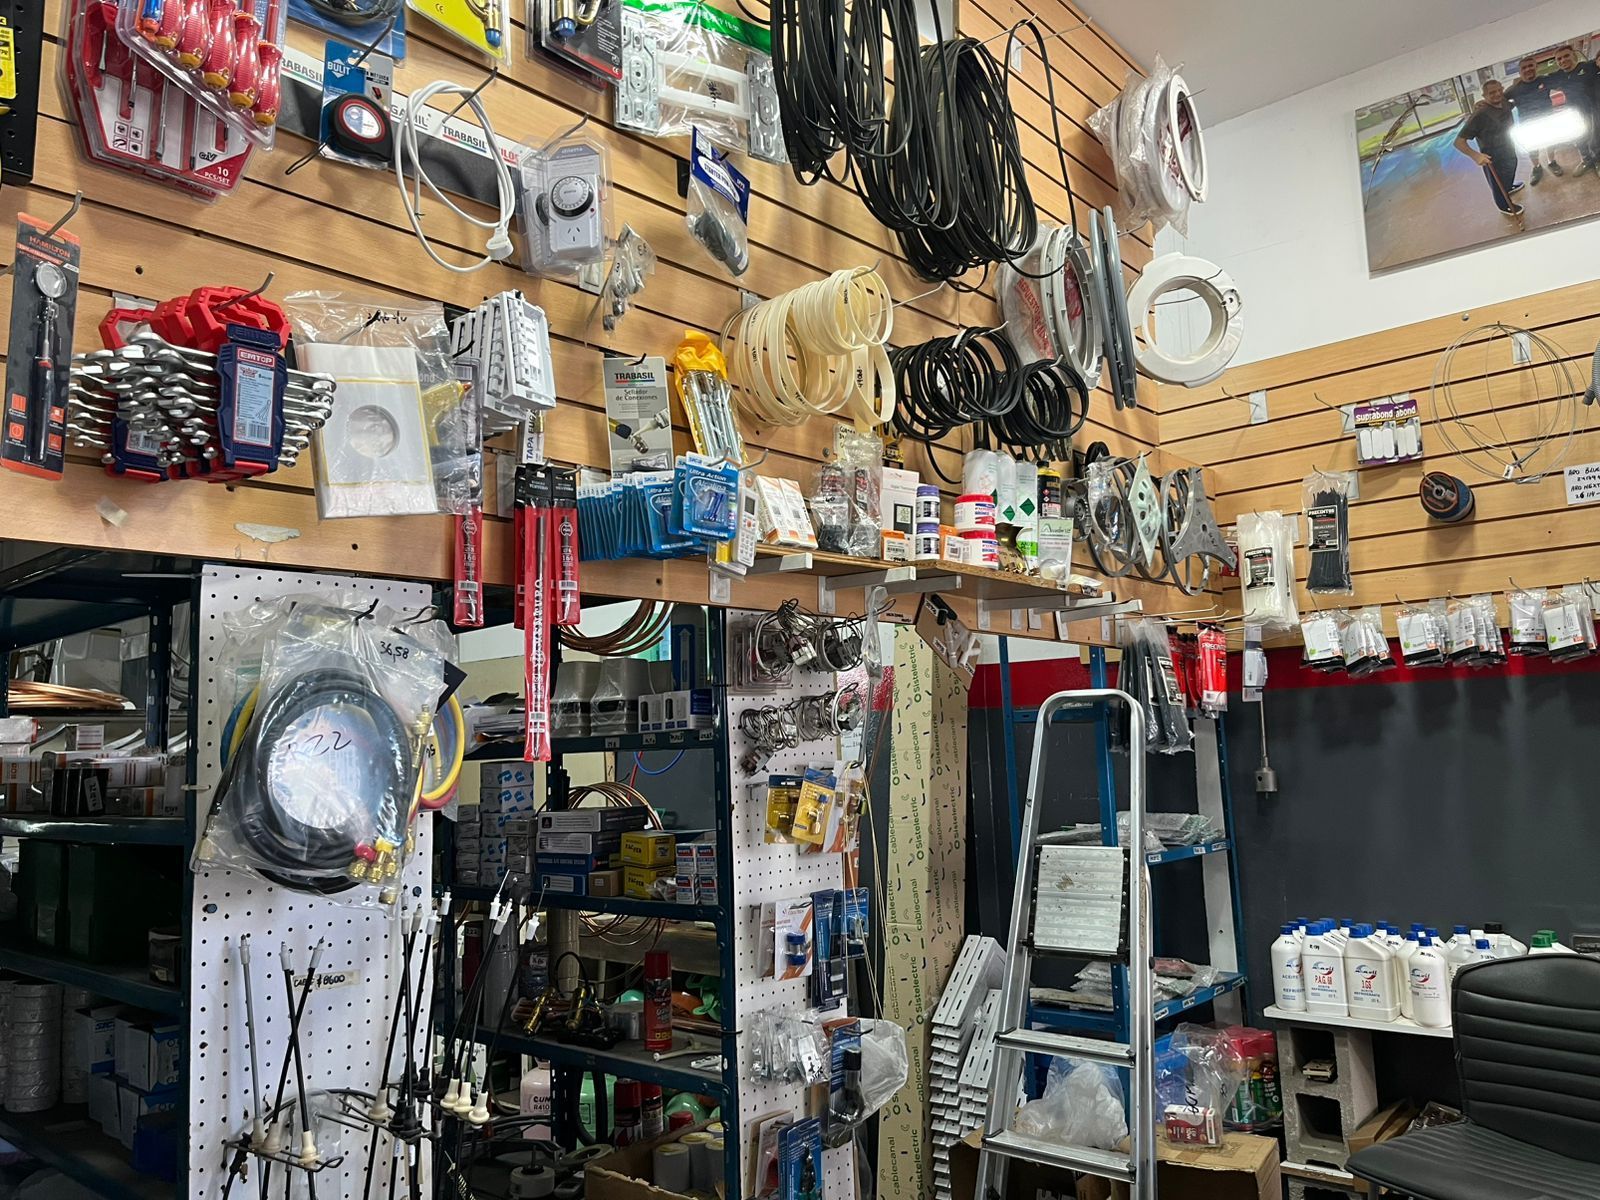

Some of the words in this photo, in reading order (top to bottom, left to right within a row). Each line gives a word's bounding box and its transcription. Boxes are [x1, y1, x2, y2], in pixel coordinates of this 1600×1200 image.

[327, 61, 351, 76] BULIT
[442, 125, 487, 150] TRABASIL
[204, 171, 231, 185] PCS/SET
[217, 166, 229, 177] 10
[29, 235, 71, 258] HAMILTON
[239, 350, 273, 364] EMTOP
[614, 372, 655, 380] TRABASIL
[1355, 409, 1393, 421] suprabond
[1396, 405, 1416, 418] abond
[526, 437, 534, 460] TAPA
[689, 468, 706, 476] Ultra
[706, 473, 727, 481] Action
[695, 480, 727, 491] Alcalina
[380, 641, 410, 662] 36,58
[908, 644, 921, 692] Sistelectric
[910, 722, 922, 770] cablecanal
[933, 713, 941, 765] Sistelectric
[911, 796, 923, 849] Sistelectric
[950, 786, 960, 838] Sistelectric
[911, 878, 923, 931] cablecanal
[952, 870, 961, 919] cablecanal
[910, 956, 923, 1013] Sistelectric
[912, 1046, 924, 1103] cablecanal
[887, 1136, 900, 1196] cablecanal
[911, 1129, 924, 1191] Sistelectric
